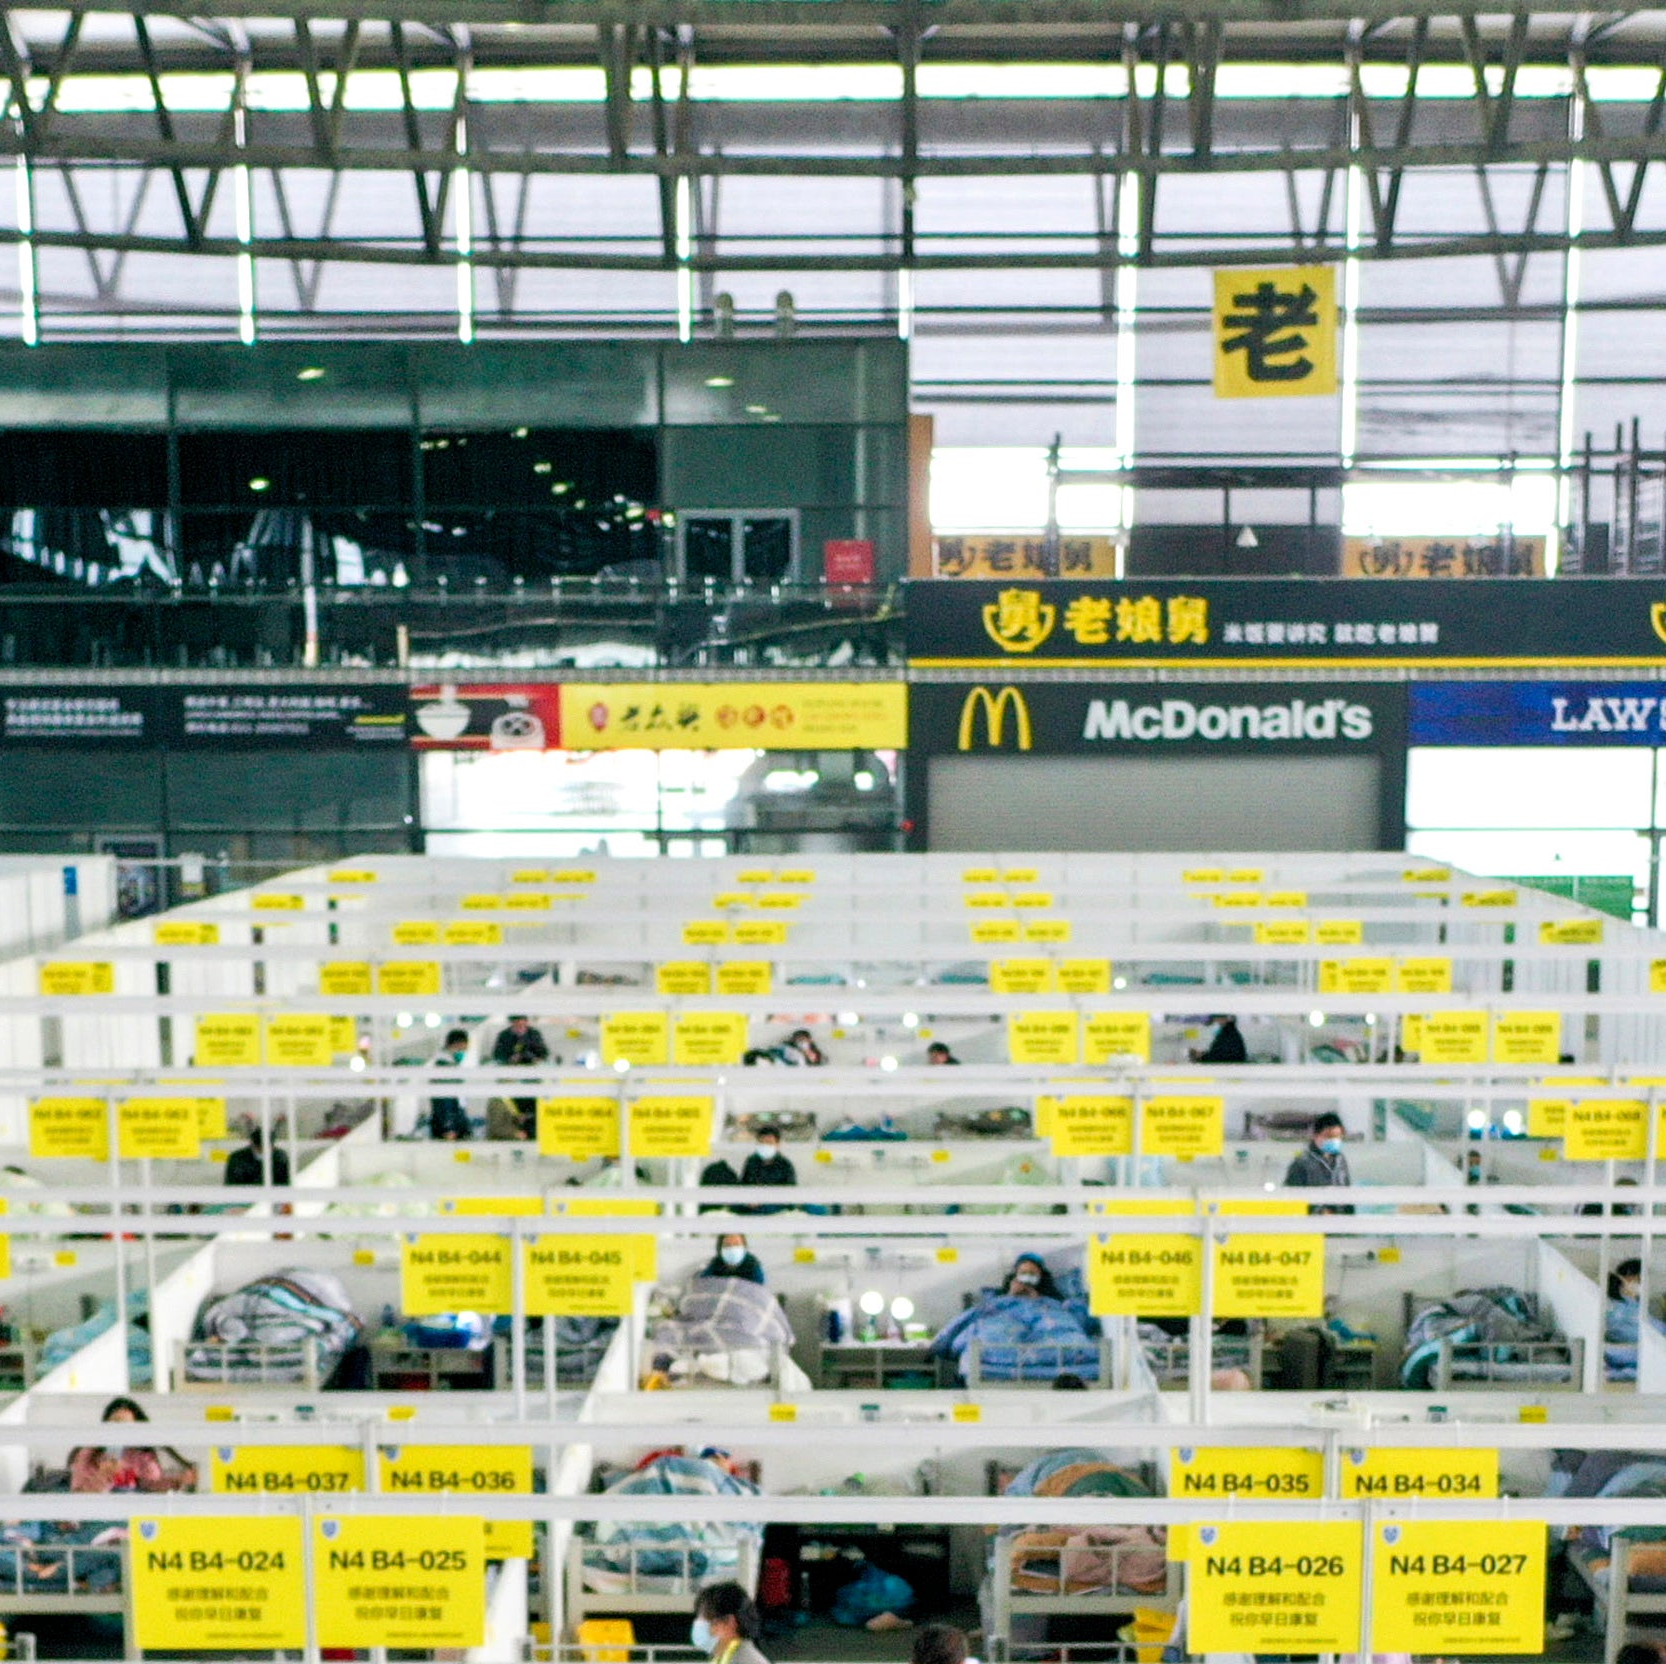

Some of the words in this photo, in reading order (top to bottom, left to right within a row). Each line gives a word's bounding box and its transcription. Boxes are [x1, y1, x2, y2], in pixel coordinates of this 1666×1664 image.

[1222, 282, 1319, 383] 老
[1064, 596, 1209, 644] 老娘舅
[1083, 700, 1372, 739] McDonald's
[1221, 1252, 1244, 1265] N4
[226, 1473, 258, 1490] N4
[263, 1473, 349, 1490] B4-037
[391, 1471, 424, 1489] N4
[429, 1471, 515, 1489] B4-036
[1185, 1474, 1217, 1493] N4
[1222, 1474, 1310, 1493] B4-035
[1356, 1475, 1388, 1493] N4
[1394, 1475, 1481, 1493] B4-034
[148, 1551, 184, 1571] N4
[190, 1551, 285, 1571] B4-024
[330, 1550, 365, 1570] N4
[371, 1550, 467, 1570] B4-025
[1207, 1556, 1242, 1576] N4
[1249, 1556, 1344, 1576] B4-026
[1391, 1555, 1426, 1575] N4
[1432, 1555, 1527, 1575] B4-027
